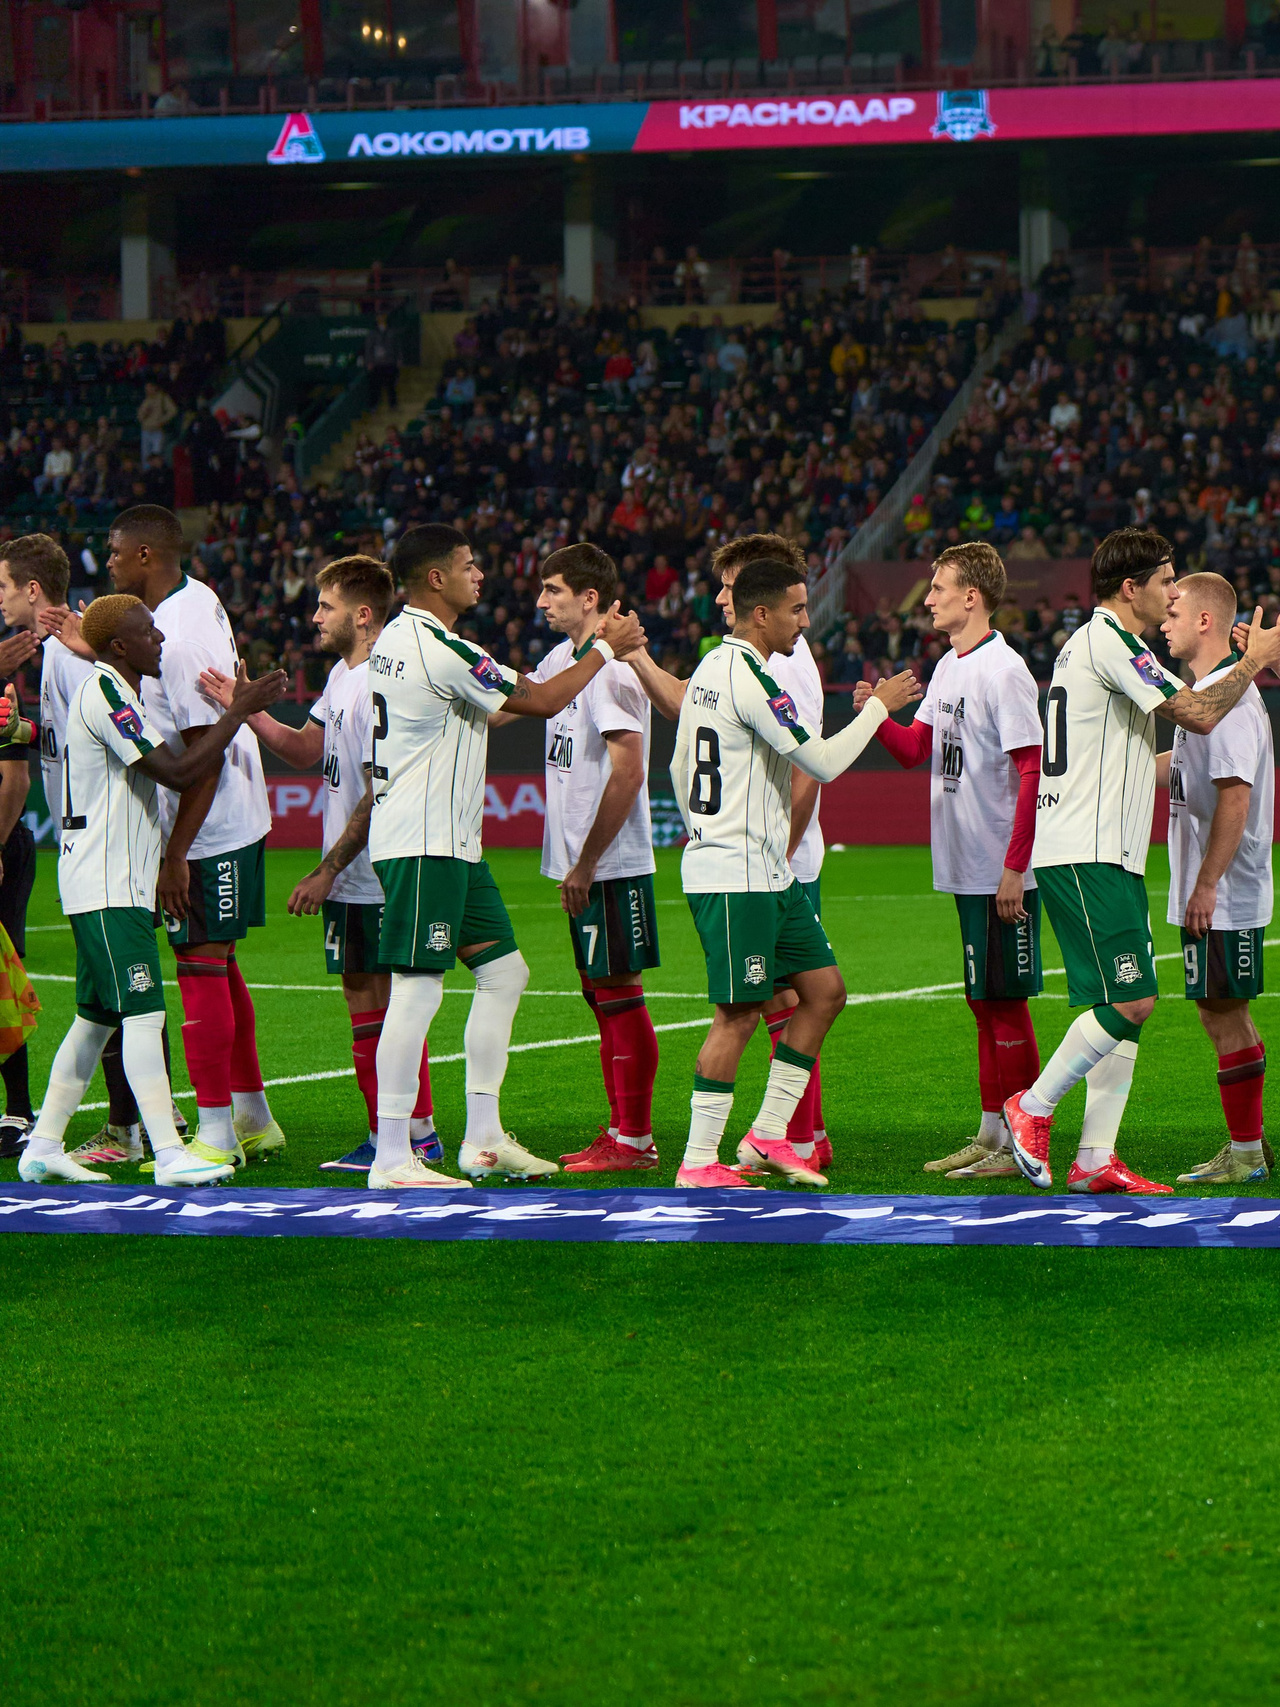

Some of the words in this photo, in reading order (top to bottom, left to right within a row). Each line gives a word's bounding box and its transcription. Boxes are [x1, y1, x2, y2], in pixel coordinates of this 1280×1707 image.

[679, 98, 917, 128] КРАСНОДАР
[348, 127, 591, 157] ЛОКОМОТИВ
[689, 726, 723, 816] 8
[217, 861, 233, 921] ТОПАЗ
[325, 921, 340, 960] 4
[628, 889, 644, 950] ТОПАЗ
[582, 924, 598, 966] 7
[1184, 944, 1199, 985] 9
[1238, 929, 1251, 979] ТОПА
